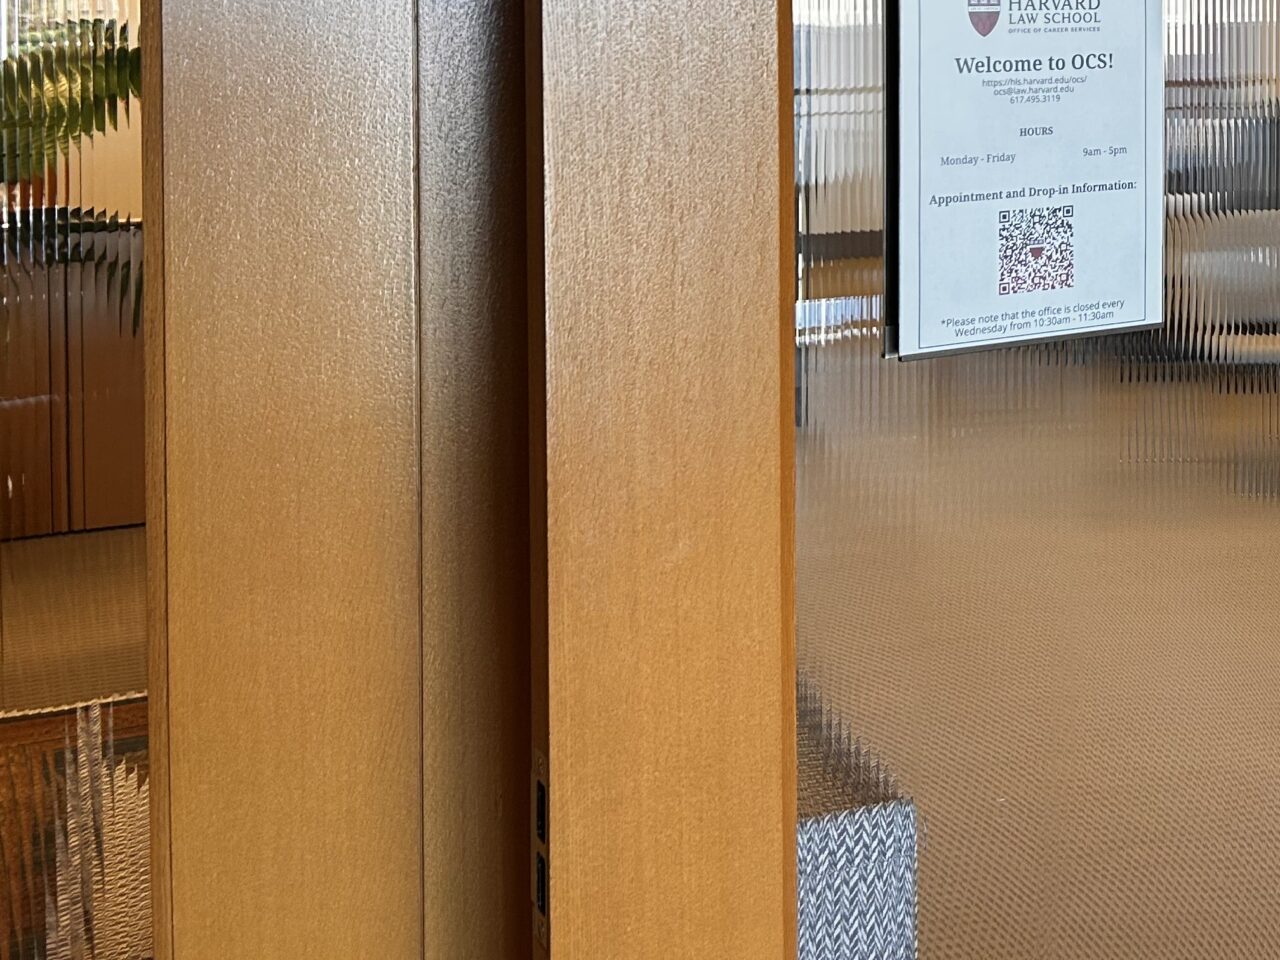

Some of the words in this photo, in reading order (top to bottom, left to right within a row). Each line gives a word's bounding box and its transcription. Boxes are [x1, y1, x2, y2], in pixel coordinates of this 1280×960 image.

[1008, 13, 1039, 25] LAW
[1043, 11, 1101, 24] SCHOOL
[954, 55, 1043, 74] Welcome
[1048, 55, 1066, 71] to
[1071, 53, 1114, 70] OCS!
[982, 76, 1088, 88] https://hls.harvard.edu/ocs/
[993, 85, 1075, 96] ocs@law.harvard.edu
[1009, 94, 1061, 104] 617.495.3119
[1019, 126, 1054, 137] HOURS
[1082, 147, 1101, 157] 9am
[1108, 146, 1127, 157] 5pm
[940, 154, 979, 167] Monday
[986, 152, 1016, 164] Friday
[929, 190, 1004, 208] Appointment
[1005, 187, 1026, 199] and
[1028, 184, 1069, 199] Drop-in
[1071, 179, 1137, 194] Information:
[977, 315, 999, 324] note
[1001, 312, 1019, 321] that
[1021, 309, 1036, 319] the
[1038, 306, 1062, 317] office
[1064, 304, 1071, 313] is
[1073, 302, 1100, 313] closed
[1101, 299, 1125, 310] every
[954, 322, 1008, 337] Wednesday
[1009, 320, 1032, 330] from
[1034, 316, 1071, 328] 10:30am
[1078, 310, 1114, 322] 11:30am
